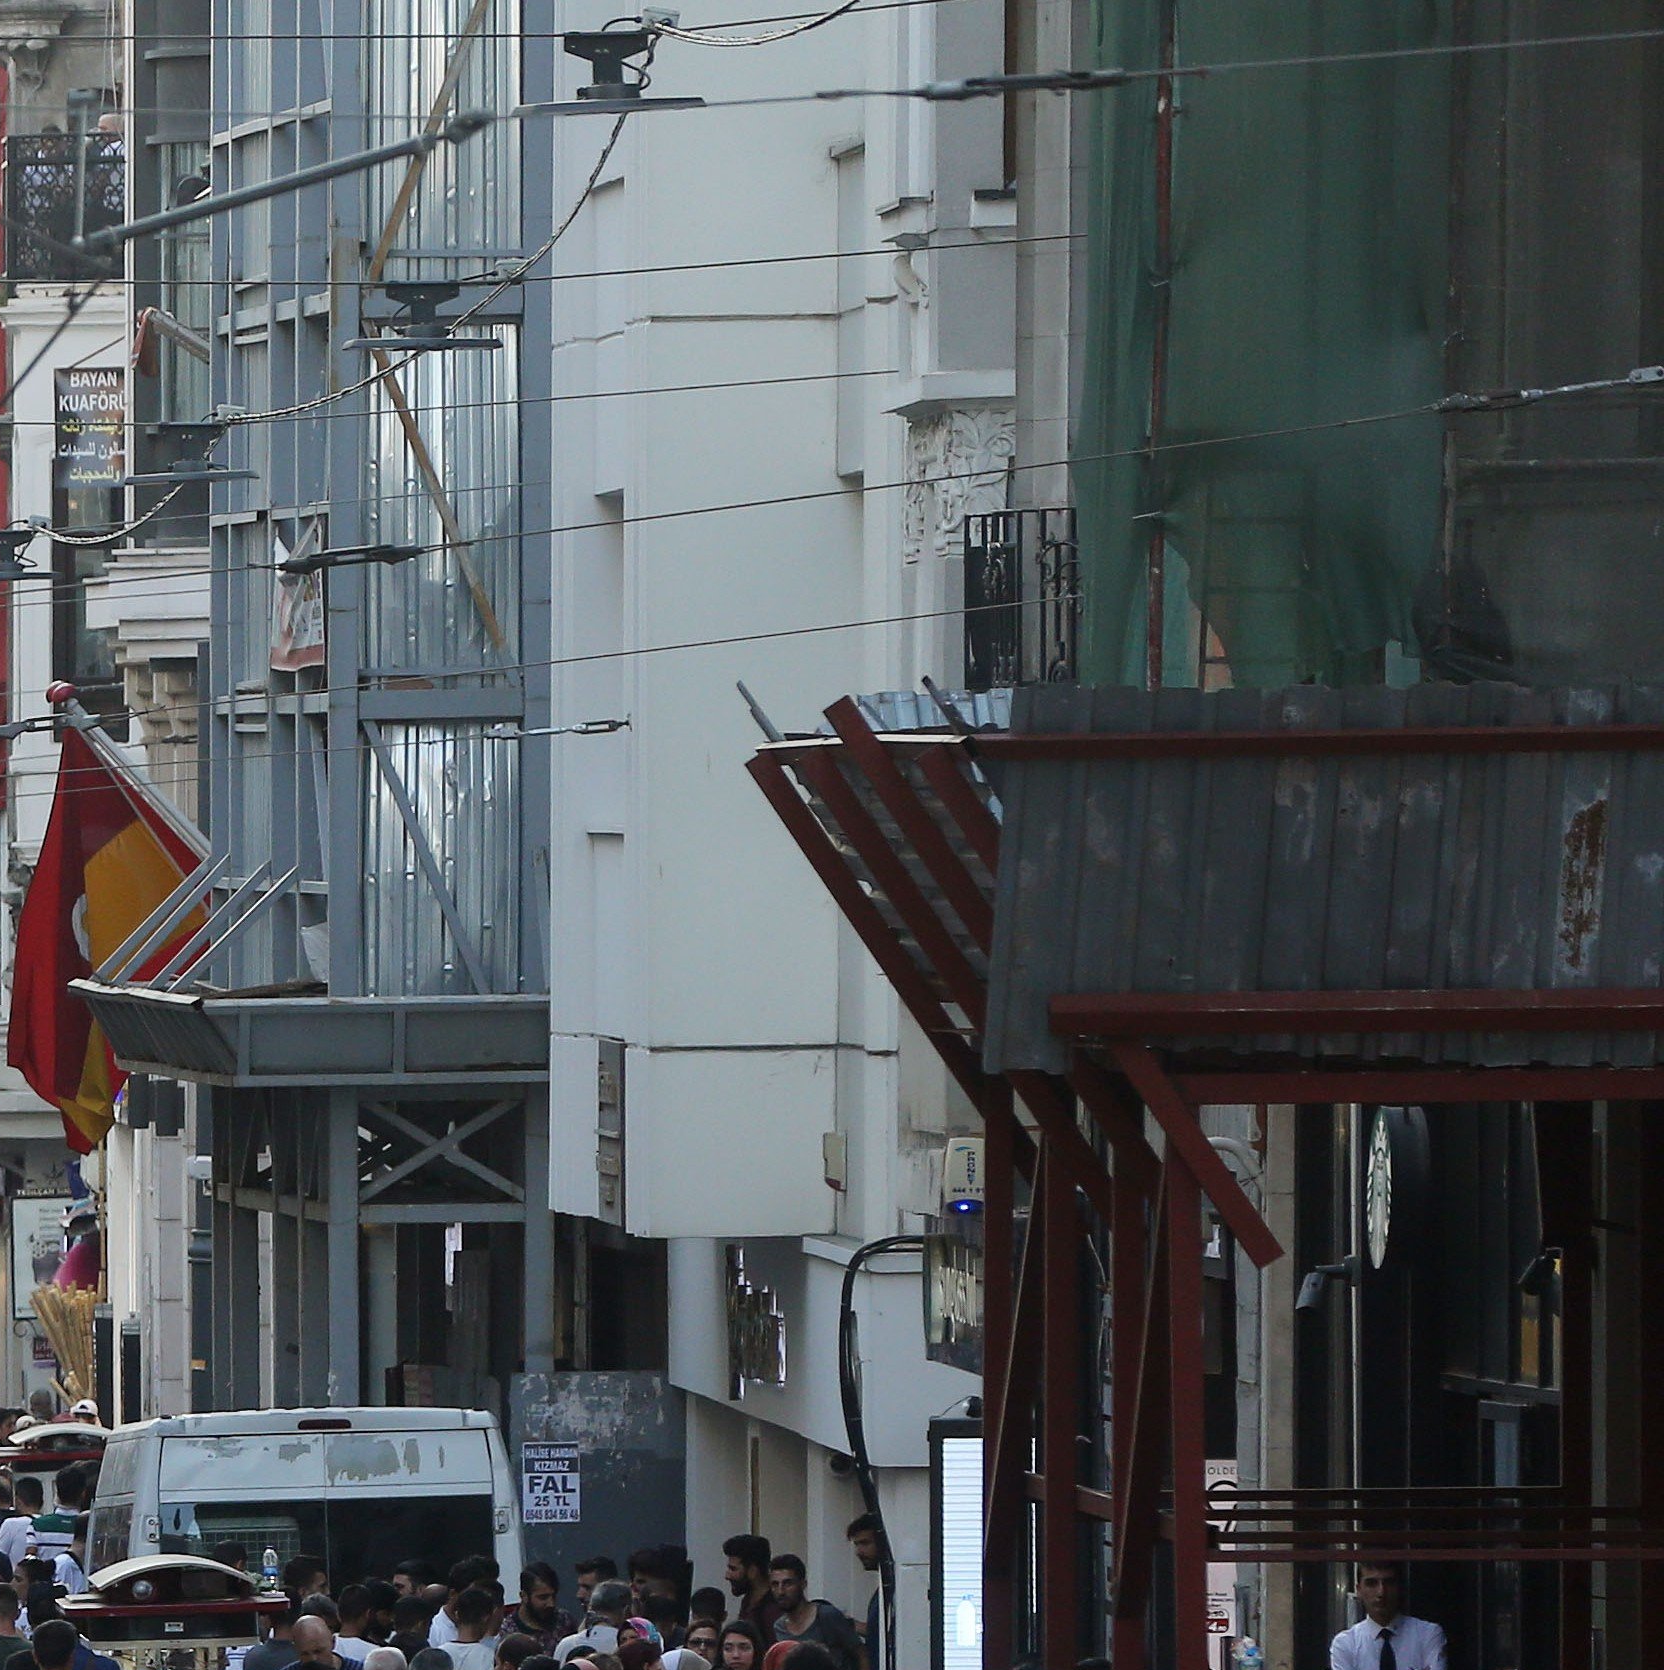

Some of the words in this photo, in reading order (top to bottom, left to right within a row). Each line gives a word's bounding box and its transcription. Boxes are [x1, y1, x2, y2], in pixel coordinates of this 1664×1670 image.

[70, 371, 118, 388] BAYAN
[534, 1460, 570, 1472] KIZMAZ
[528, 1475, 577, 1494] FAL
[534, 1495, 550, 1507] 25
[554, 1495, 570, 1507] TL
